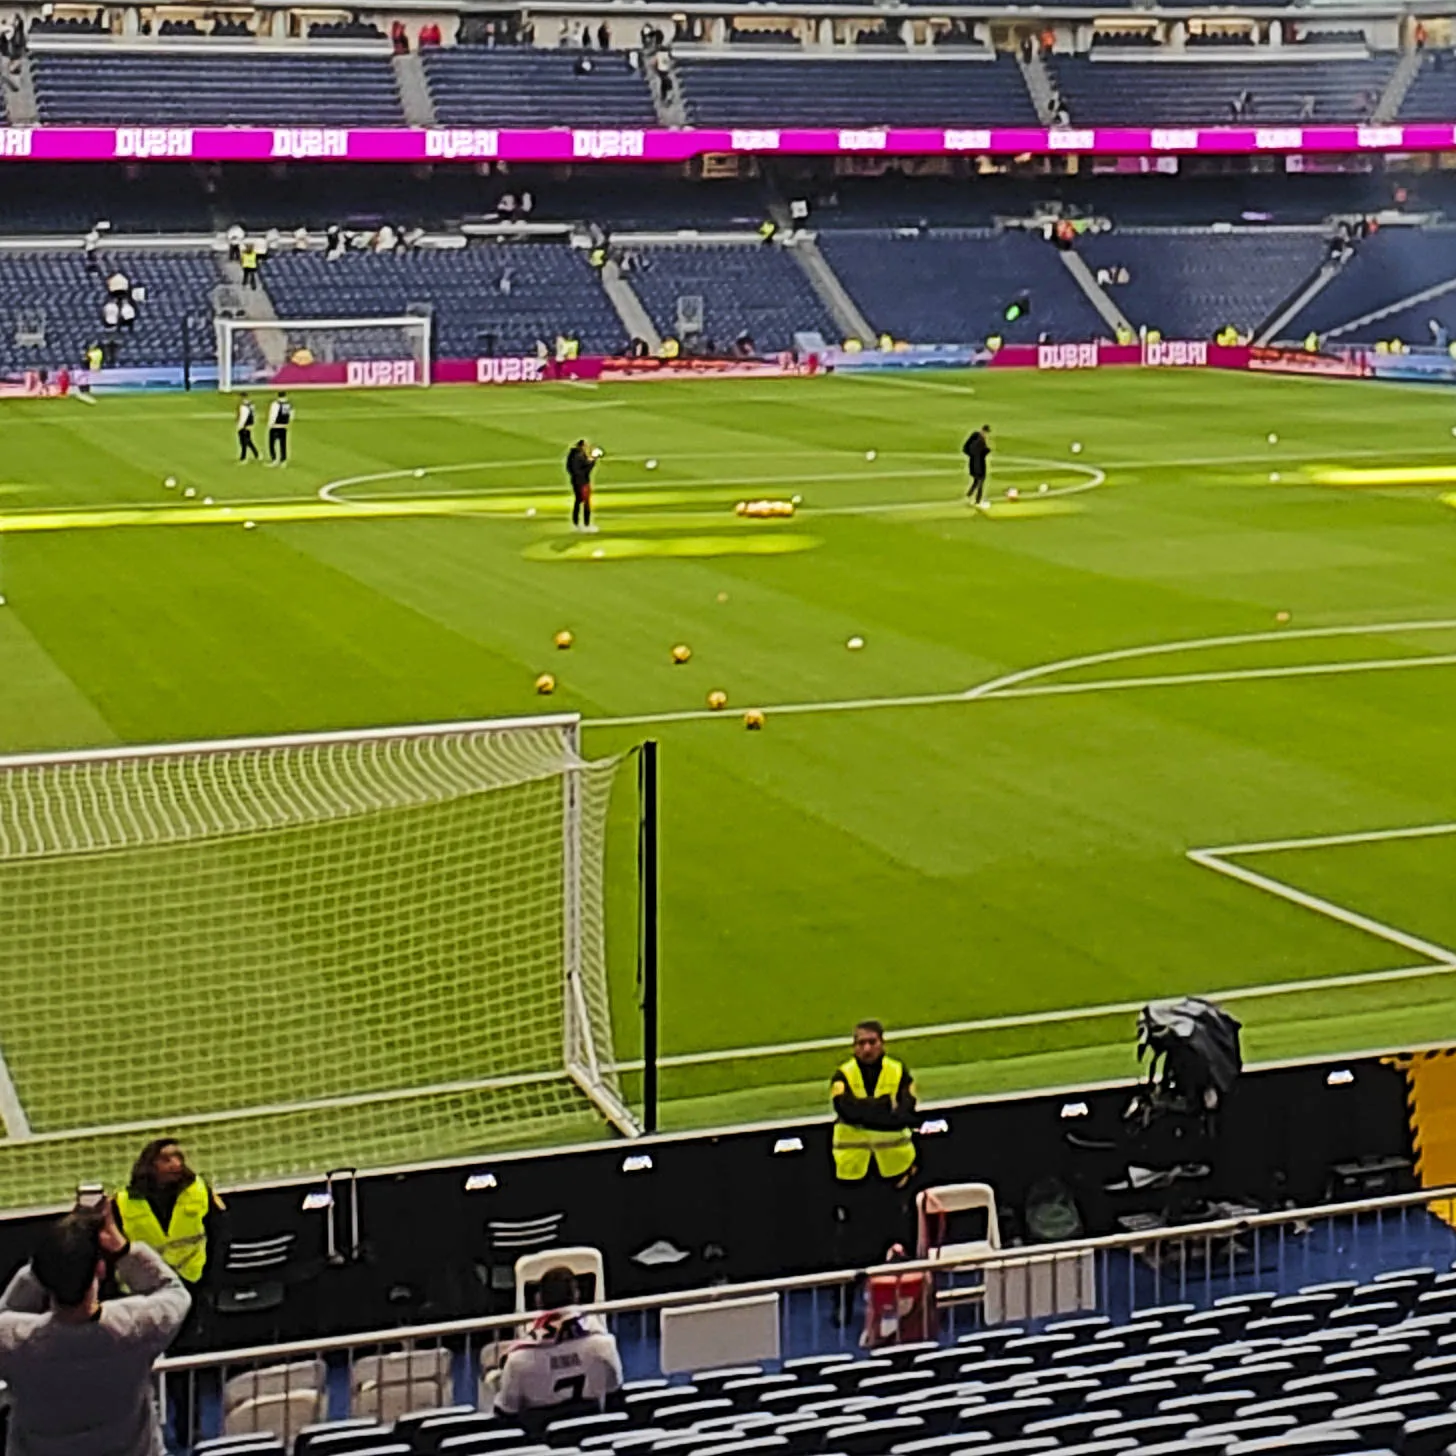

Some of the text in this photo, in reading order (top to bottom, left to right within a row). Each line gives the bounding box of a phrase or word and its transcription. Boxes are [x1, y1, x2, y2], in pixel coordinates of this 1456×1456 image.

[115, 128, 193, 157] DUBAI
[272, 129, 349, 158] DUBAI
[425, 129, 499, 158] DUBAI
[573, 130, 645, 158] DUBAI
[1038, 343, 1098, 368] DUBAI
[347, 360, 415, 385] DUBAI
